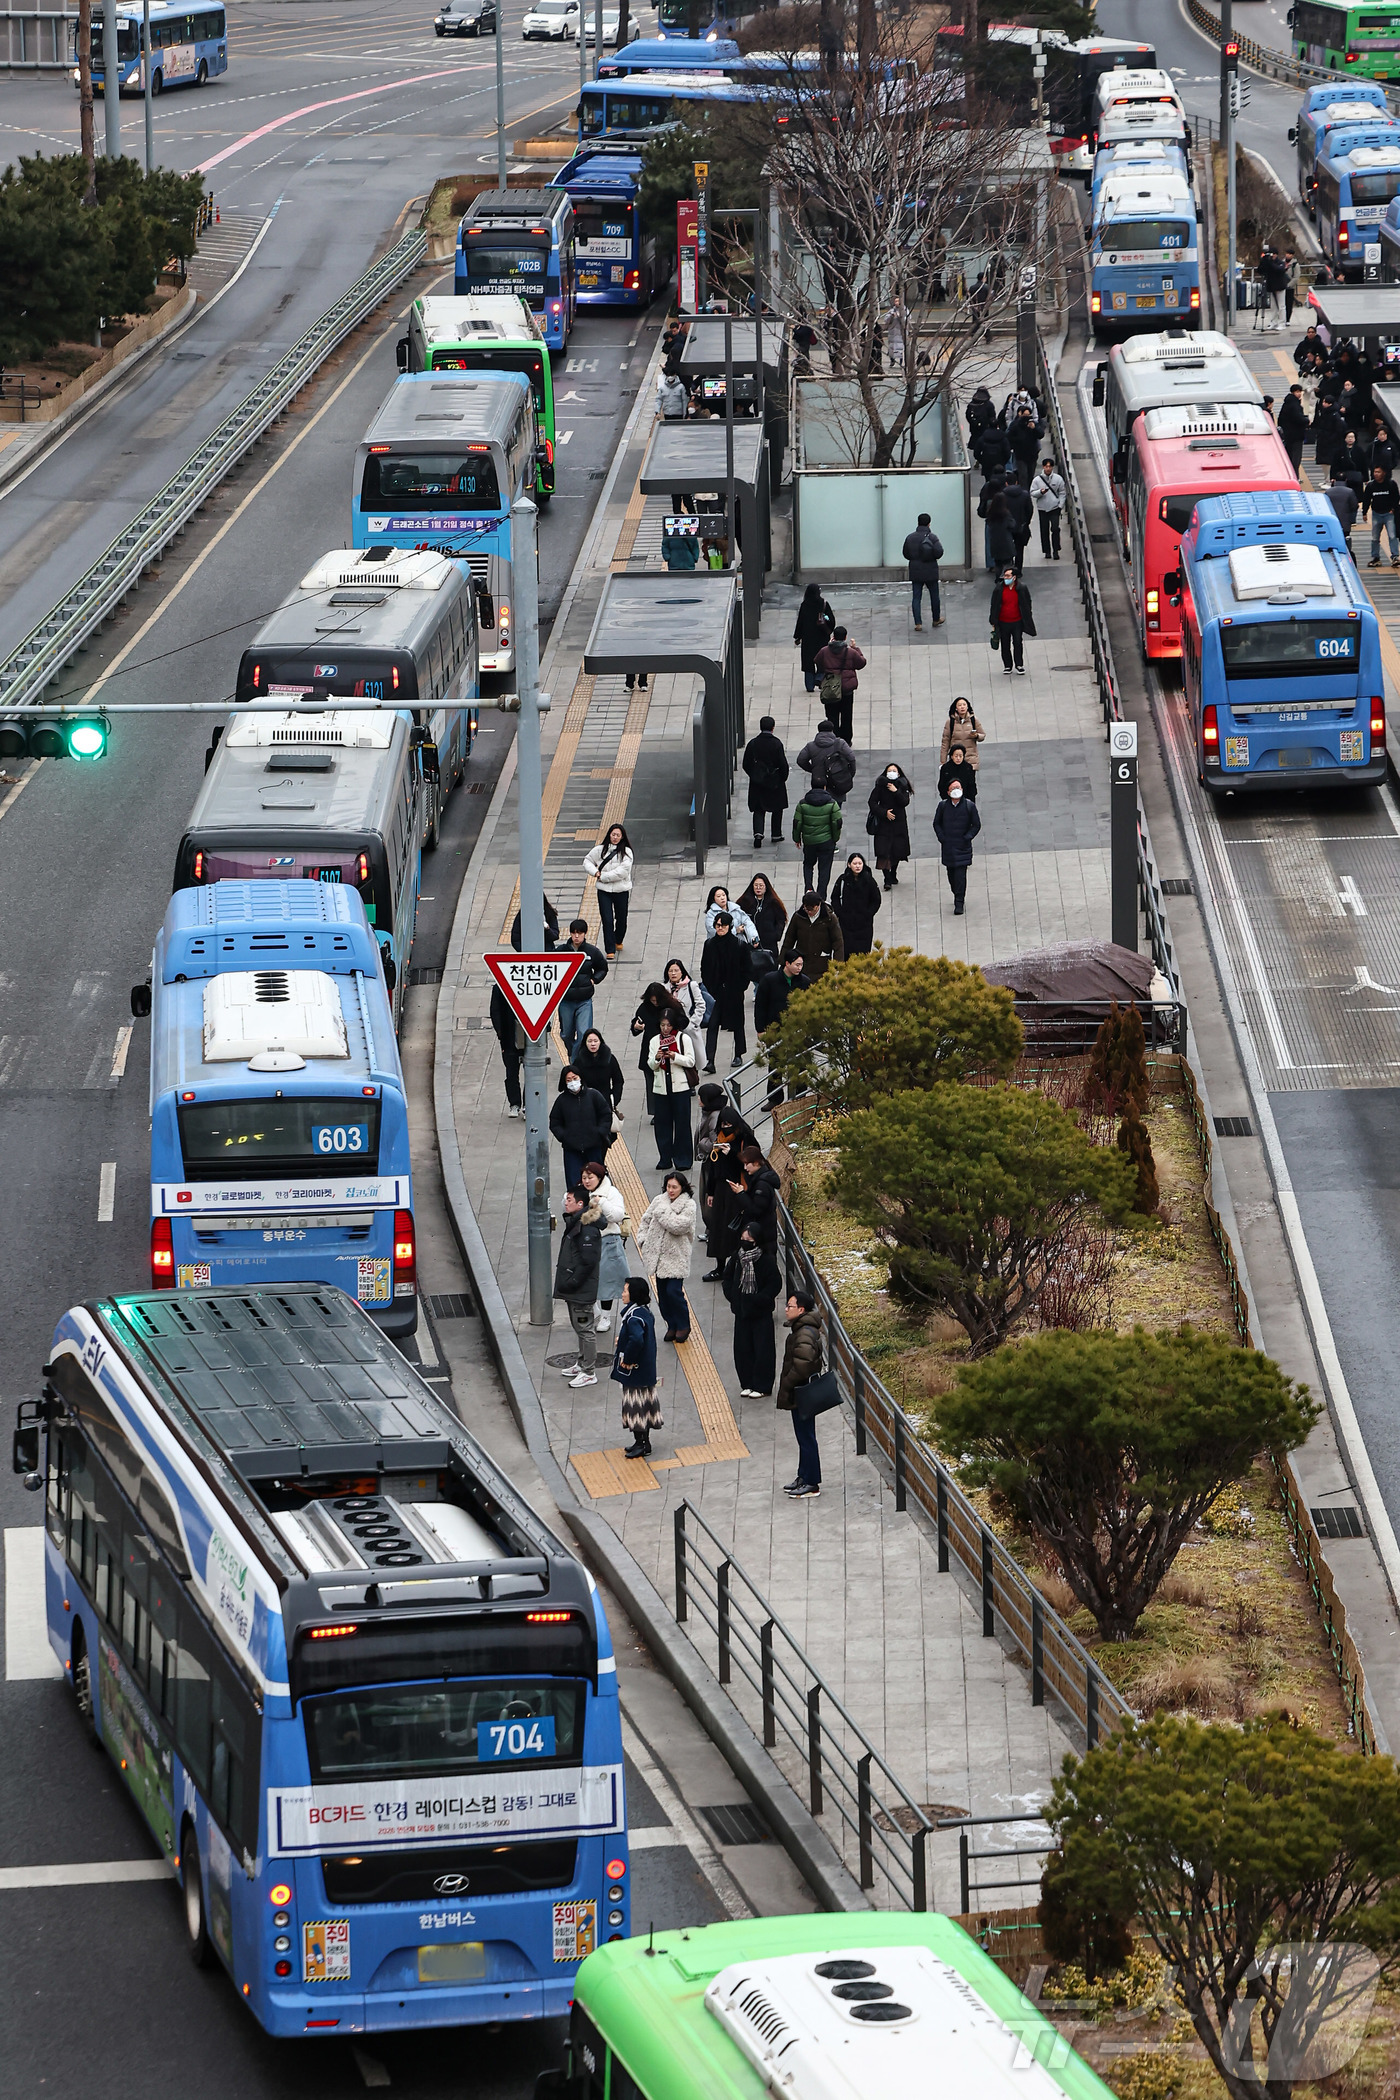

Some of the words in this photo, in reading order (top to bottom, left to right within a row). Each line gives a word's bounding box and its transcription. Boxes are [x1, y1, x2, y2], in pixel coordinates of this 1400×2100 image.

[698, 191, 706, 213] 서울역
[605, 225, 622, 235] 709
[1161, 235, 1180, 247] 401
[518, 261, 541, 271] 702B
[1370, 266, 1377, 277] 5
[470, 285, 512, 294] NH투자증권
[513, 285, 544, 294] 퇴직연금
[392, 519, 430, 529] 드래곤소드
[430, 519, 442, 529] 1월
[442, 519, 457, 529] 21일
[459, 519, 474, 529] 정식
[1318, 638, 1350, 657] 604
[1254, 702, 1334, 713] HYUNDAI
[1278, 712, 1308, 722] 신길교통
[1118, 762, 1131, 780] 6
[509, 964, 558, 981] 천천히
[517, 982, 553, 996] SLOW
[317, 1126, 363, 1153] 603
[226, 1215, 342, 1230] HYUNDAI
[262, 1230, 307, 1242] 중부운수
[194, 1268, 210, 1281] 주의
[359, 1262, 375, 1275] 주의
[489, 1721, 545, 1756] 704
[415, 1795, 496, 1818] 레이디스컵
[502, 1795, 534, 1812] 감동!
[537, 1792, 578, 1808] 그대로
[418, 1912, 477, 1930] 한남버스
[554, 1906, 575, 1926] 주의
[326, 1925, 348, 1944] 주의
